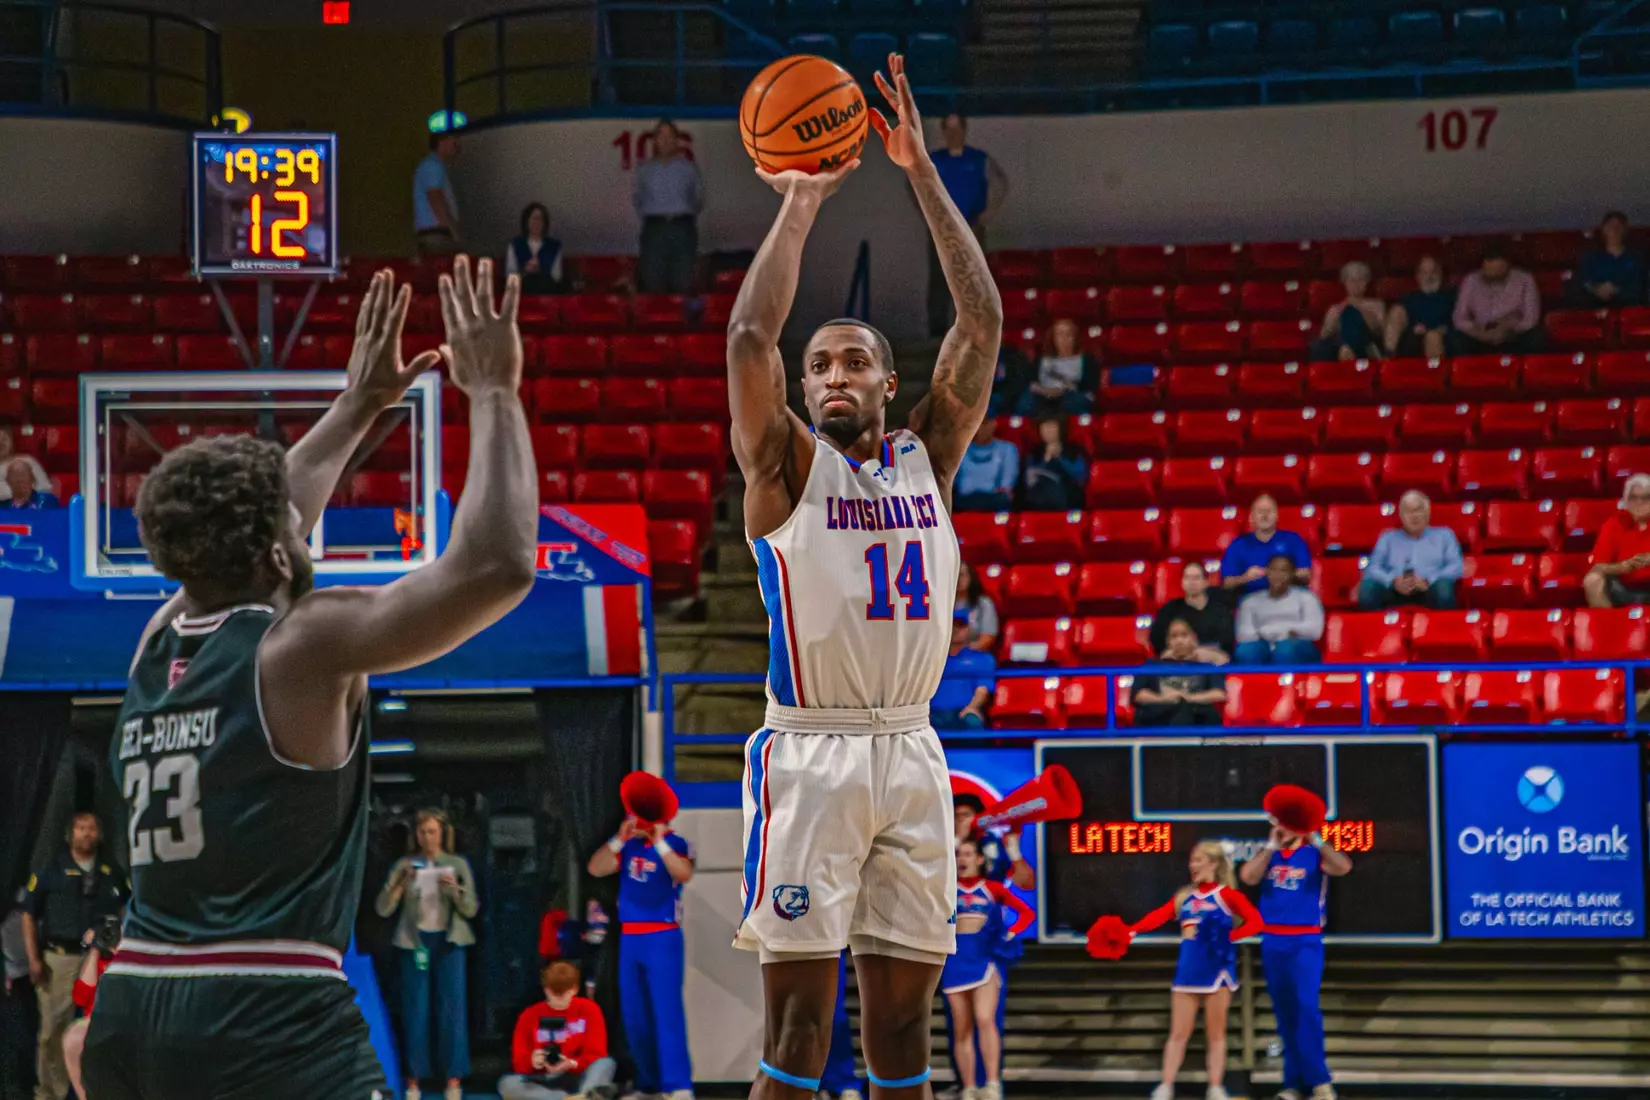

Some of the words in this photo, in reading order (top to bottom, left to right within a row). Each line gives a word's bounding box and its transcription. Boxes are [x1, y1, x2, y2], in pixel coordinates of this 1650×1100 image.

[792, 99, 864, 144] Wilson
[1416, 106, 1498, 153] 107
[224, 148, 320, 187] 19:39
[250, 189, 310, 259] 12
[864, 539, 931, 622] 14
[123, 754, 205, 867] 23
[1458, 826, 1549, 861] Origin
[1558, 824, 1630, 854] Bank
[1460, 912, 1482, 926] OF
[1486, 912, 1505, 926] LA
[1509, 912, 1550, 926] TECH
[1553, 911, 1635, 926] ATHLETICS
[1470, 893, 1500, 907] THE
[1504, 893, 1573, 907] OFFICIAL
[1577, 893, 1621, 907] BANK
